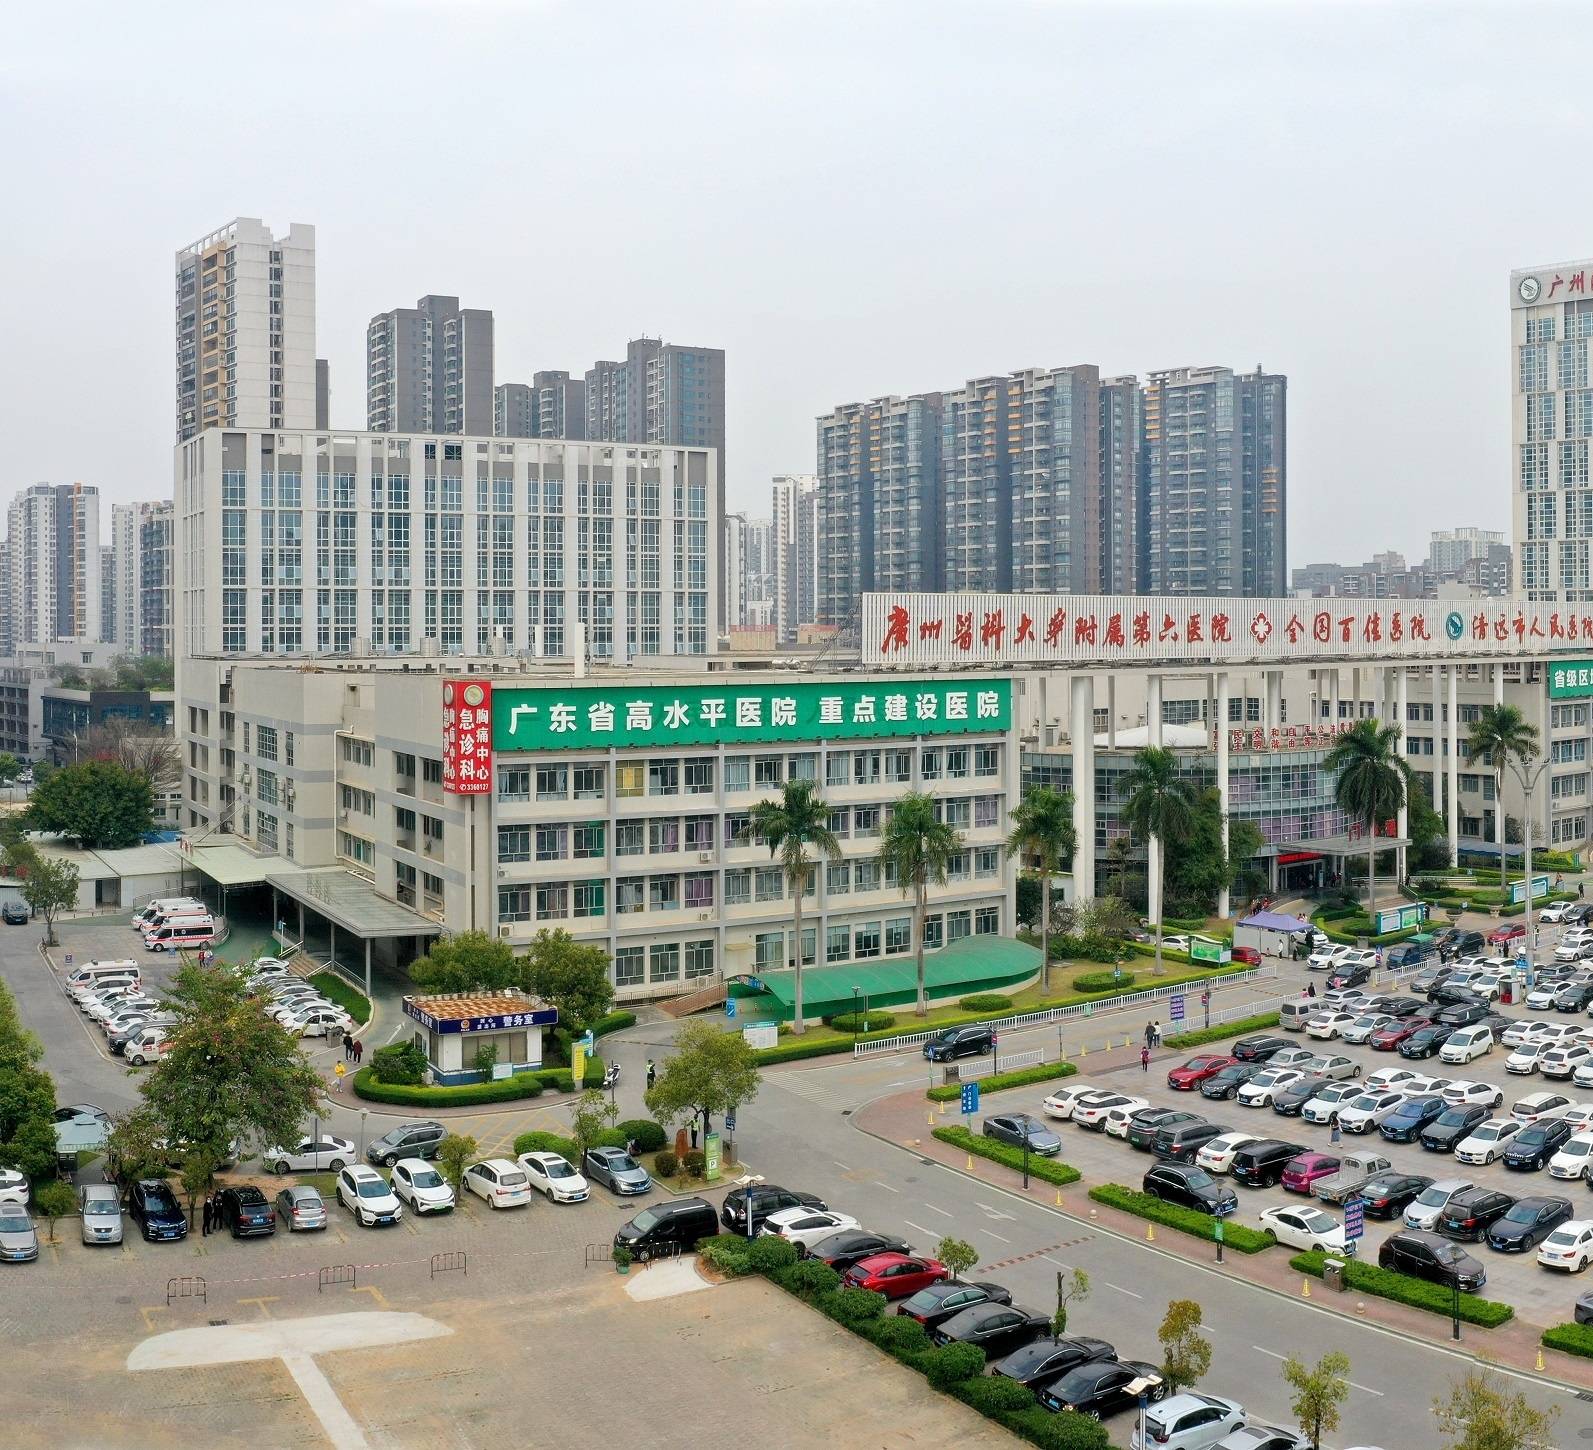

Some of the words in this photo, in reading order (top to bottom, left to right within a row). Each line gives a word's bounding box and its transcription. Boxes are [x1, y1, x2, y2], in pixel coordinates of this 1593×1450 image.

[1284, 612, 1431, 643] 全国百佳医院
[508, 697, 797, 735] 广东省高水平医院
[818, 690, 999, 725] 重点建设医院
[459, 708, 475, 781] 急诊科
[476, 708, 489, 780] 胸痛中心
[503, 1013, 534, 1027] 警务室
